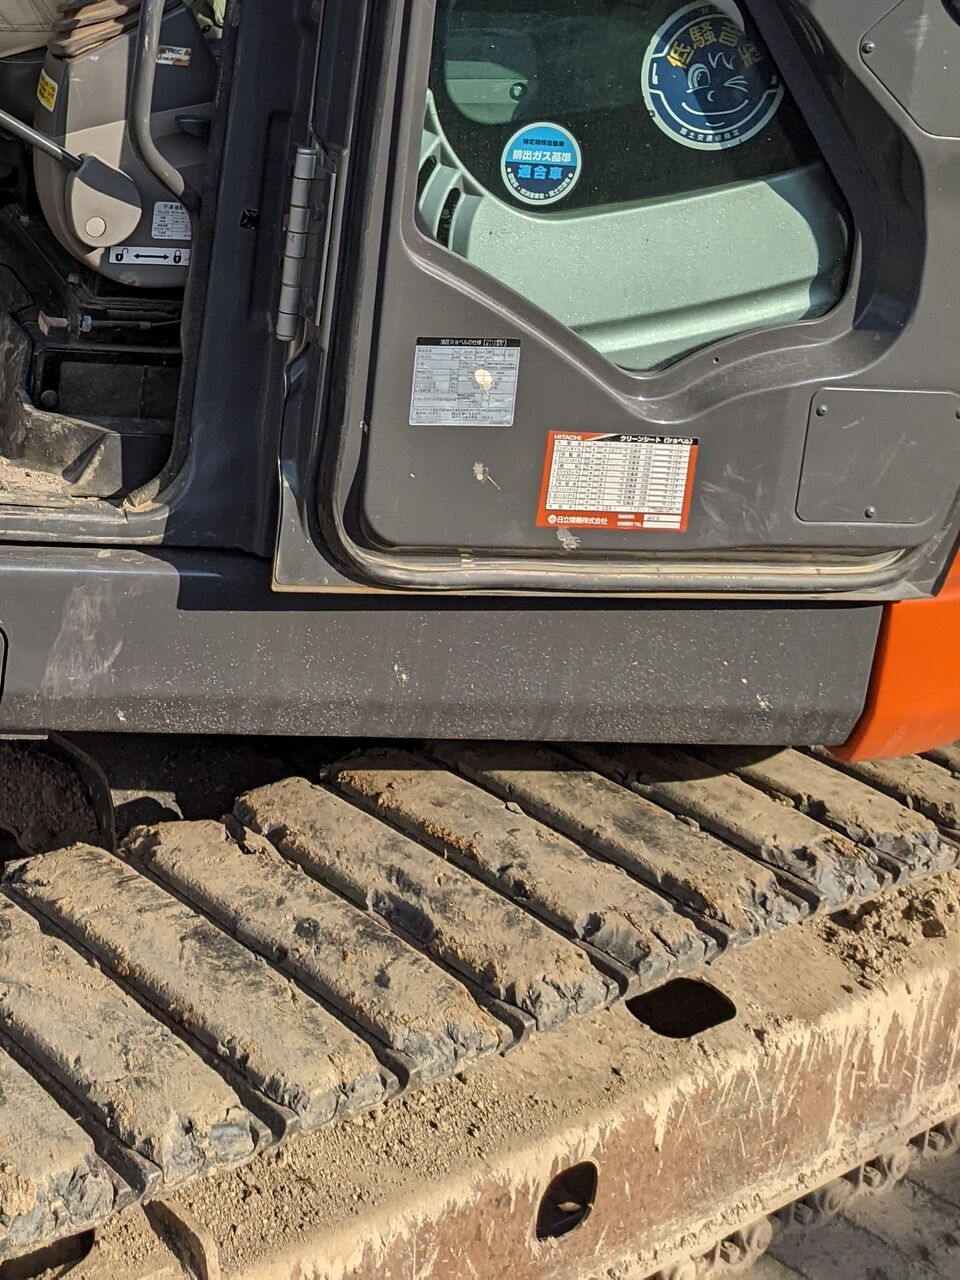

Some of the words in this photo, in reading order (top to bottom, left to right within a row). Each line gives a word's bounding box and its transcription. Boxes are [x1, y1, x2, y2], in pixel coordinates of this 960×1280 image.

[512, 149, 572, 163] 排出ガス基準
[518, 164, 563, 180] 適合車
